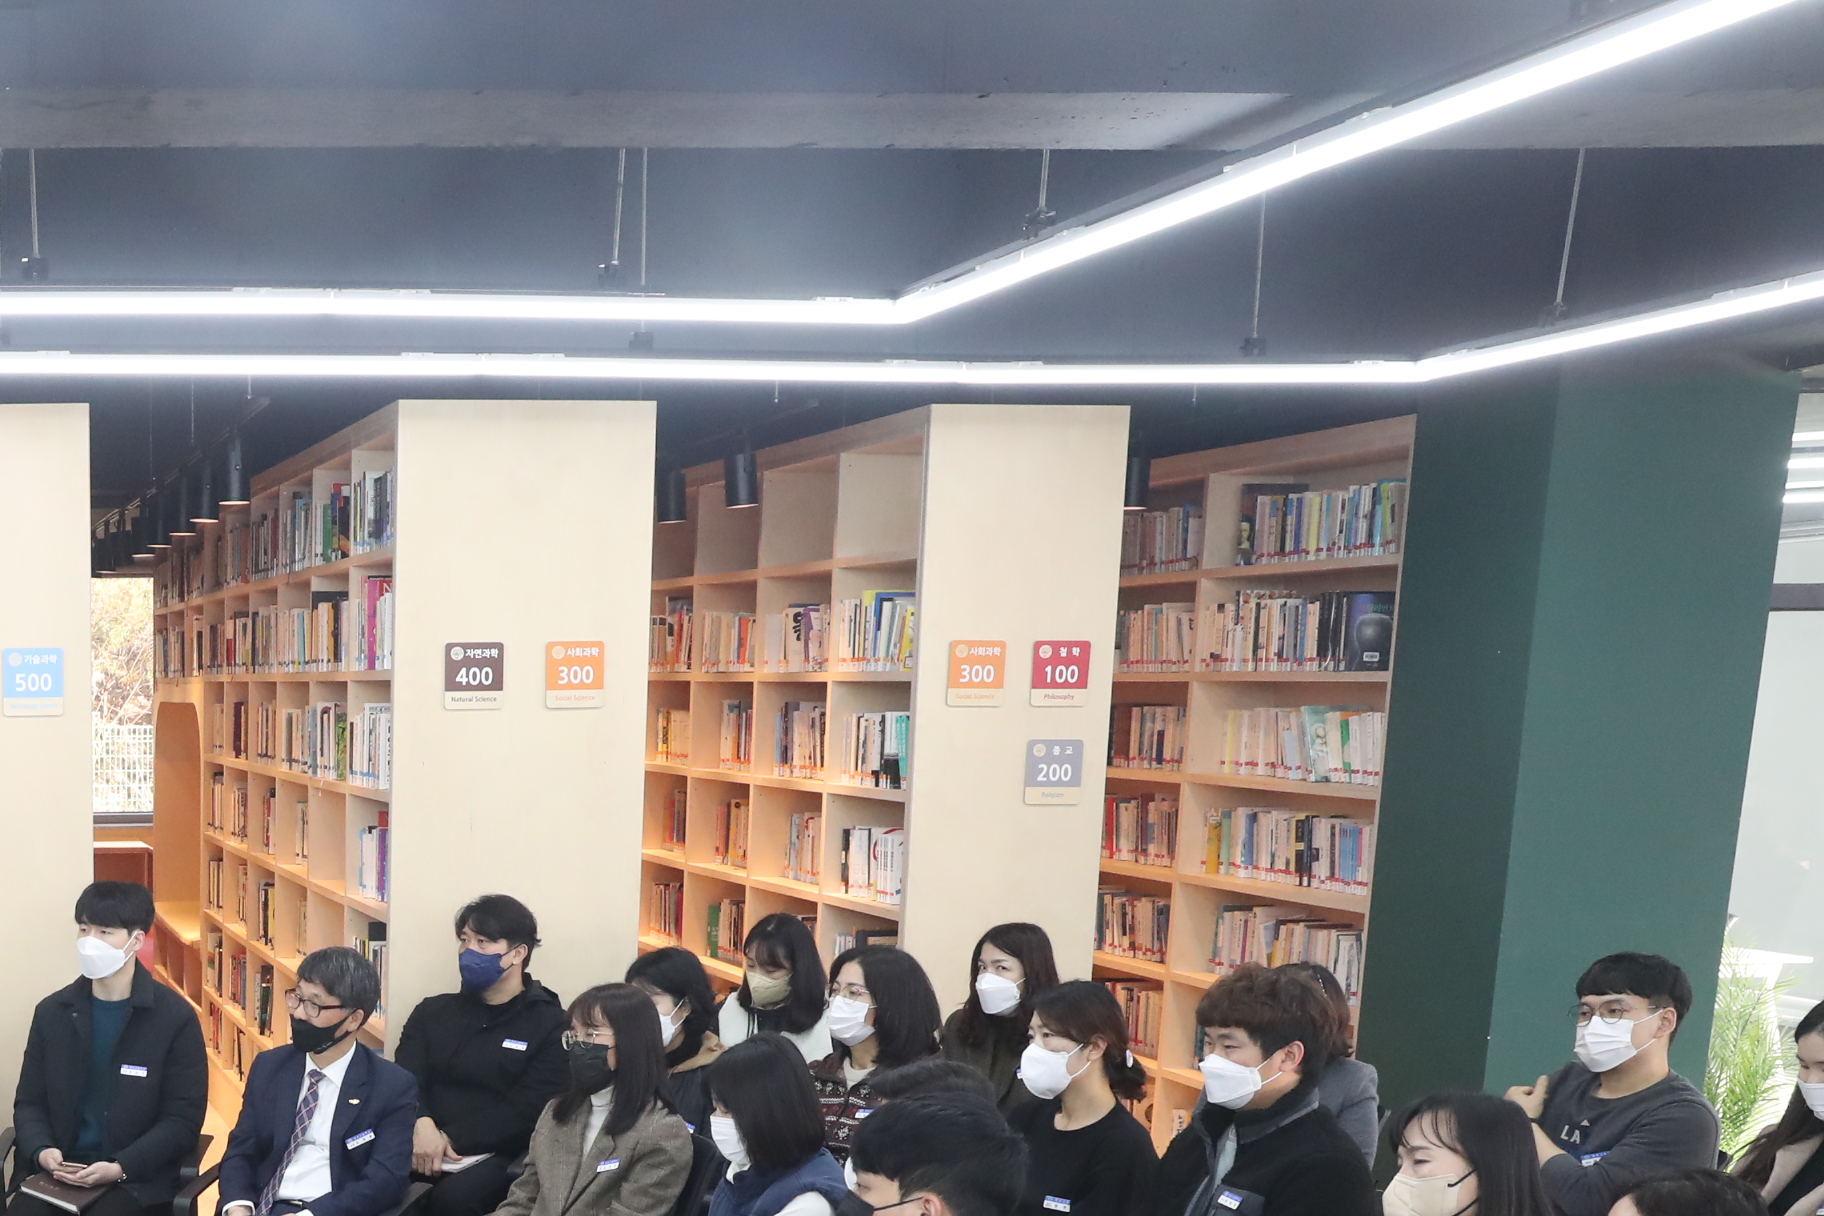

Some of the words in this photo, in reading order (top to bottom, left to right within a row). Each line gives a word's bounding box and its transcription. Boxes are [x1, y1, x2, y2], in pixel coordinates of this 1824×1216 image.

[24, 654, 58, 665] 기술과학
[466, 648, 498, 658] 자연과학
[567, 647, 600, 657] 사회과학
[969, 646, 1001, 656] 사회과학
[15, 673, 52, 692] 500
[455, 667, 493, 686] 400
[557, 665, 594, 685] 300
[959, 664, 995, 683] 300
[1044, 665, 1079, 683] 100
[1037, 763, 1072, 782] 200
